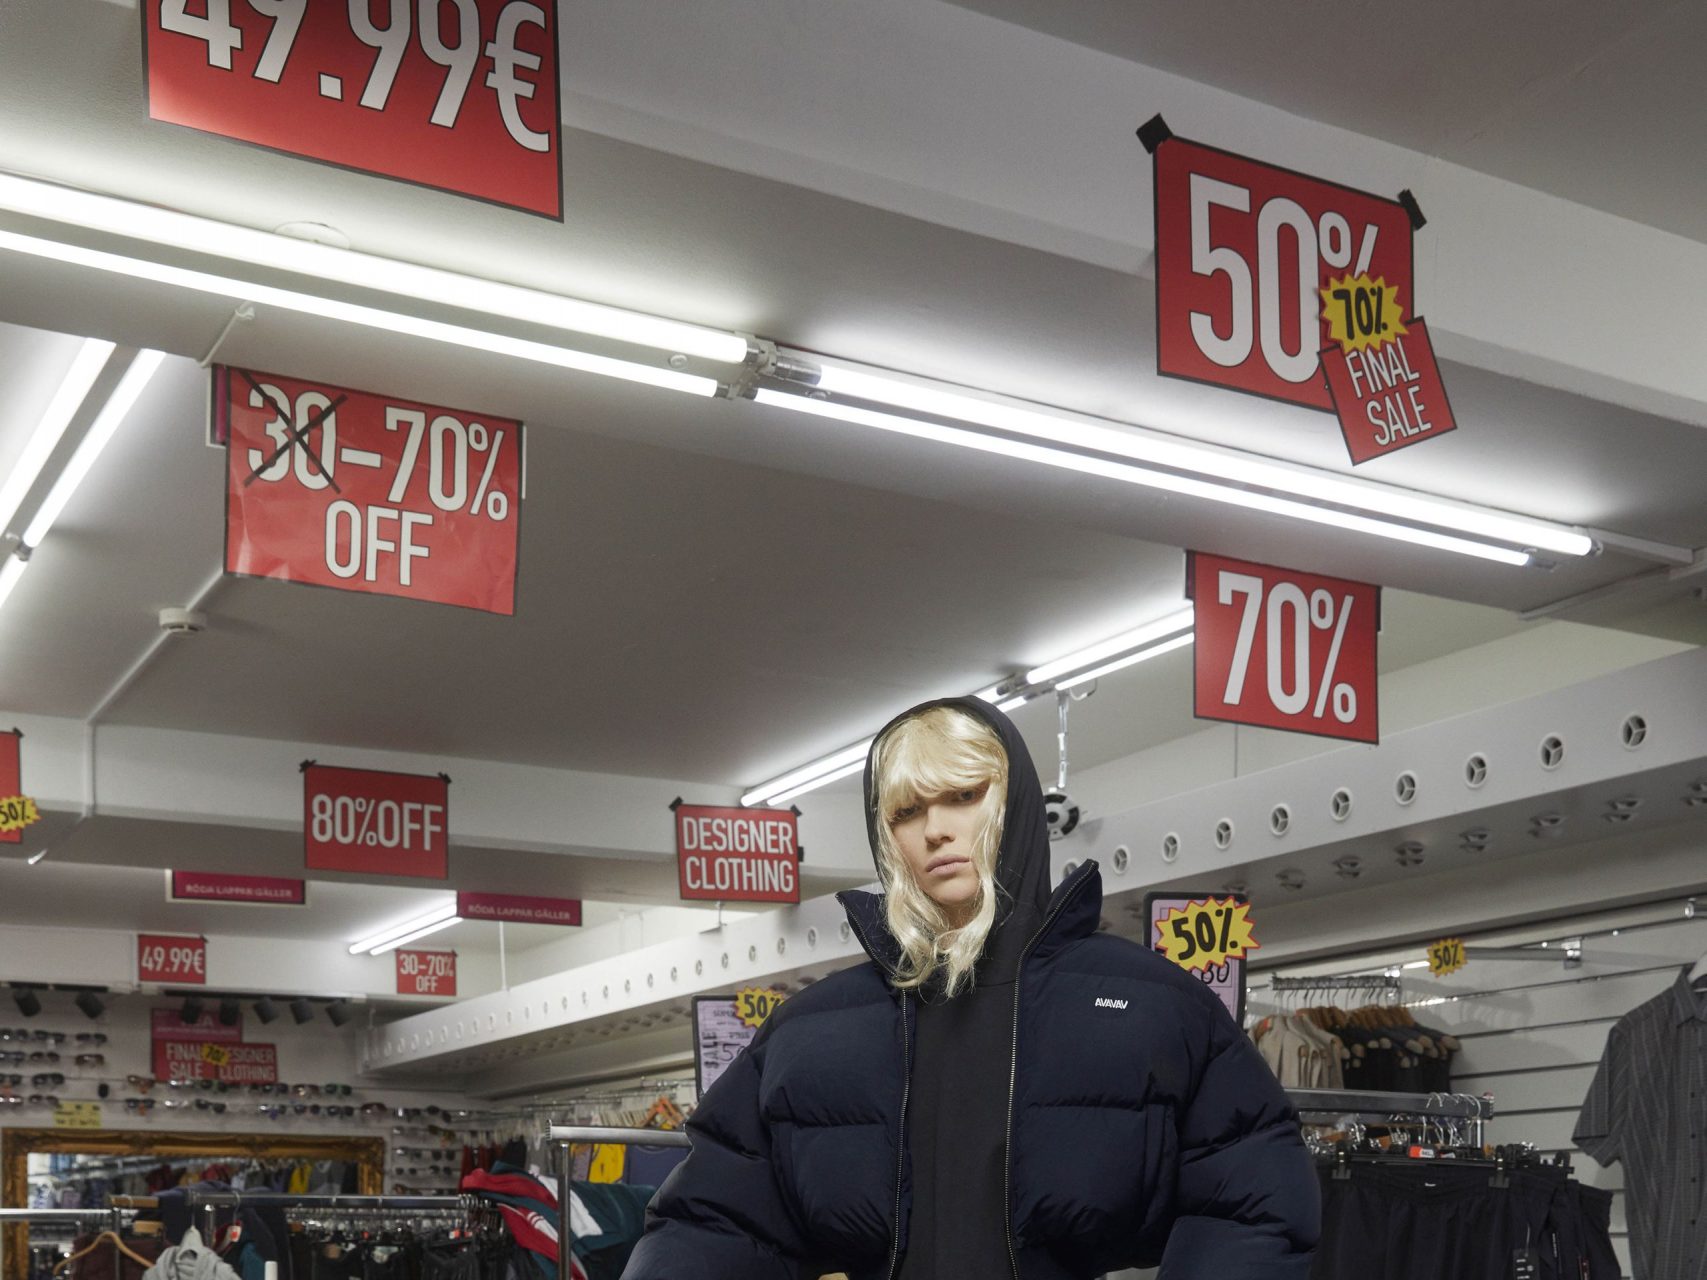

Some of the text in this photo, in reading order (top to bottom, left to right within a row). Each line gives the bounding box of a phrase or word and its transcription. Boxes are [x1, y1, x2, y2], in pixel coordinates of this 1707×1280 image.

[1333, 285, 1389, 341] 70%
[1345, 337, 1421, 399] FINAL
[1366, 386, 1432, 446] SALE
[325, 499, 434, 586] OFF
[1217, 570, 1358, 724] 70%
[682, 817, 794, 855] DESIGNER
[685, 855, 795, 893] CLOTHING
[1171, 907, 1239, 961] 50%
[141, 946, 204, 974] 49.99€
[1433, 945, 1460, 970] 50%
[416, 975, 439, 993] OFF
[1094, 997, 1129, 1010] AVAVAV
